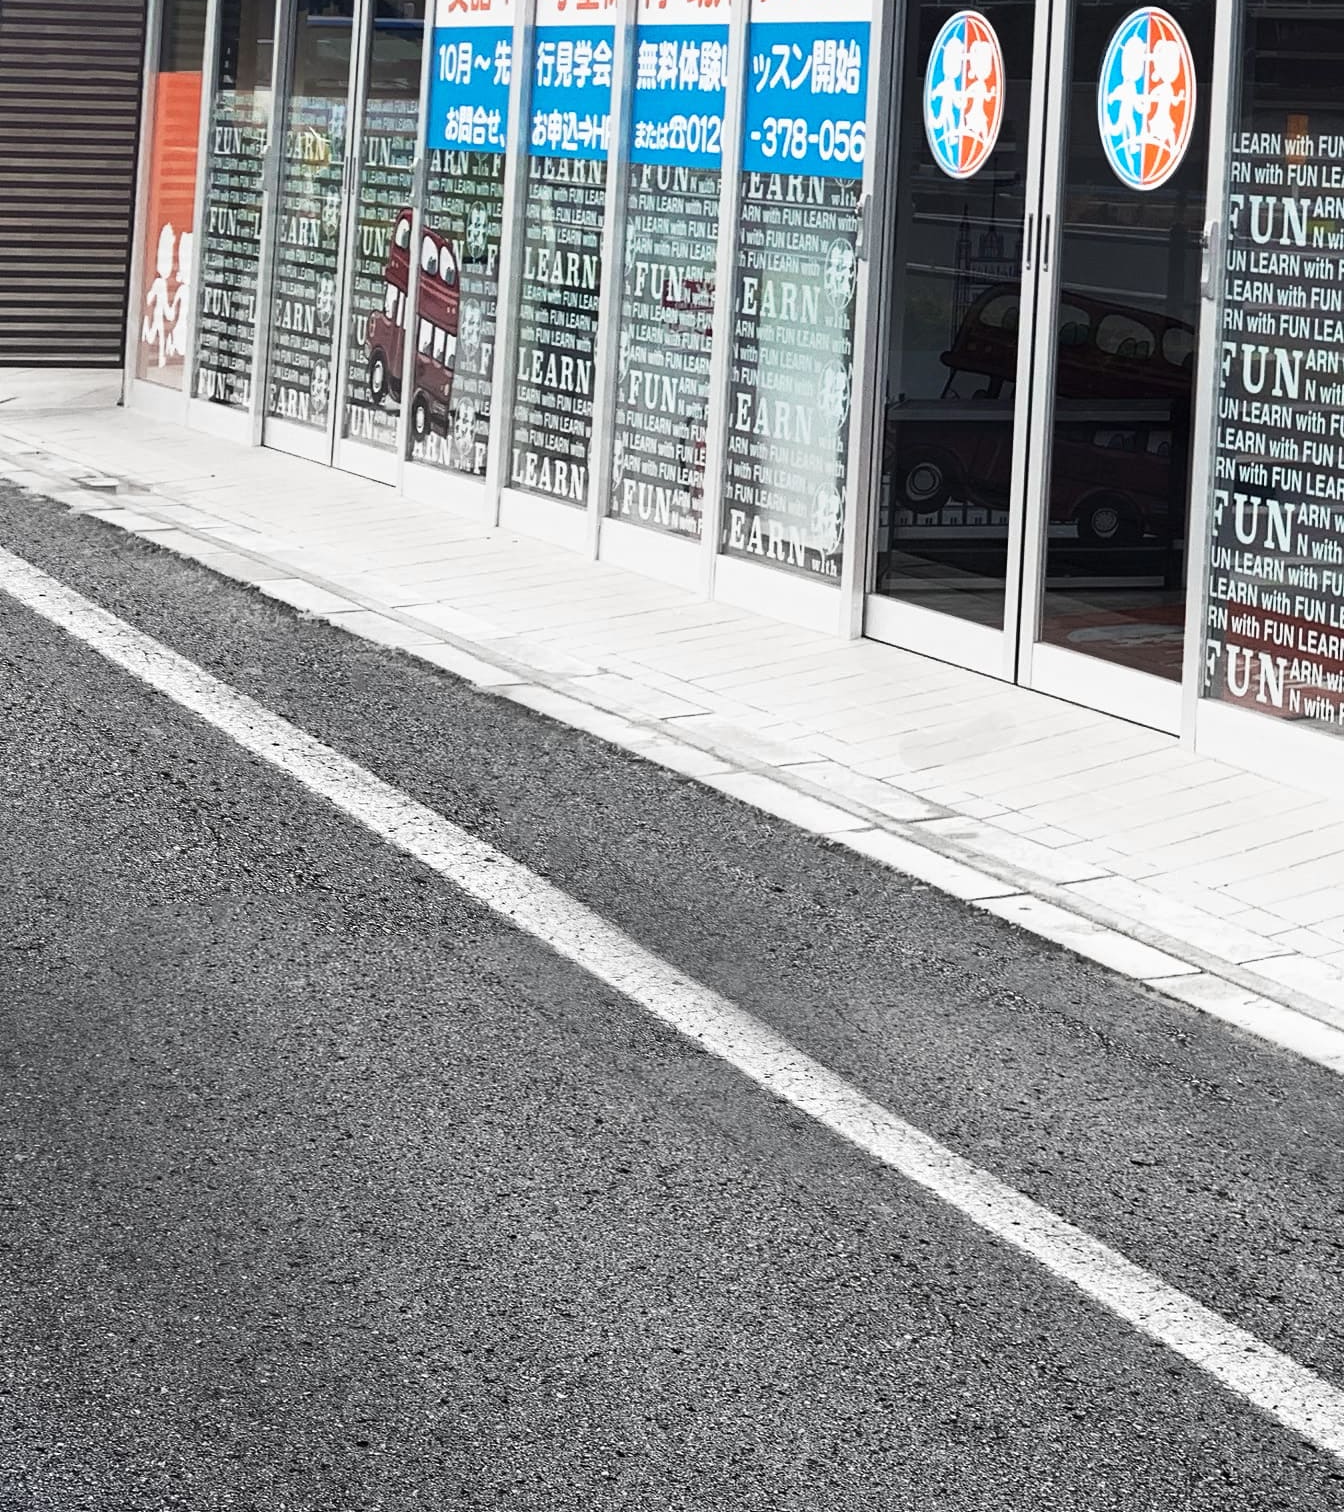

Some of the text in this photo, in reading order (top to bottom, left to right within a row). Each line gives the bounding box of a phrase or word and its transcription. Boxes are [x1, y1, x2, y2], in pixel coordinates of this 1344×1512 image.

[536, 39, 612, 88] 行見学会
[753, 38, 861, 95] ッスン開始
[1232, 132, 1281, 156] LEARN
[1285, 134, 1314, 157] with
[1254, 163, 1283, 185] with
[1287, 164, 1317, 187] FUN
[782, 209, 802, 226] FUN
[803, 210, 836, 230] LEARN
[1228, 194, 1311, 246] FUN
[524, 246, 598, 290] LEARN
[634, 261, 684, 302] FUN
[1249, 251, 1300, 275] LEARN
[1304, 255, 1335, 279] with
[203, 287, 232, 317] FUN
[742, 276, 820, 325] EARN
[1225, 279, 1273, 304] LEARN
[1277, 285, 1306, 308] with
[1310, 288, 1342, 312] FUN
[1247, 311, 1276, 334] with
[1279, 315, 1310, 339] FUN
[517, 346, 592, 394] LEARN
[627, 369, 678, 413] FUN
[1219, 342, 1303, 400] FUN
[735, 392, 812, 445] EARN
[1242, 399, 1292, 425] LEARN
[1295, 406, 1326, 431] with
[1216, 426, 1266, 455] LEARN
[1268, 435, 1299, 462] with
[1302, 441, 1334, 469] FUN
[511, 448, 585, 501] LEARN
[1239, 461, 1268, 488] with
[1271, 467, 1302, 493] FUN
[621, 478, 672, 525] FUN
[1211, 489, 1295, 553] FUN
[729, 508, 805, 567] EARN
[1234, 549, 1285, 577] LEARN
[1287, 559, 1318, 586] with
[1209, 575, 1258, 608] LEARN
[1261, 589, 1291, 618] with
[1294, 596, 1326, 624] FUN
[1230, 612, 1260, 640] with
[1264, 619, 1295, 648] FUN
[1204, 639, 1286, 708] FUN
